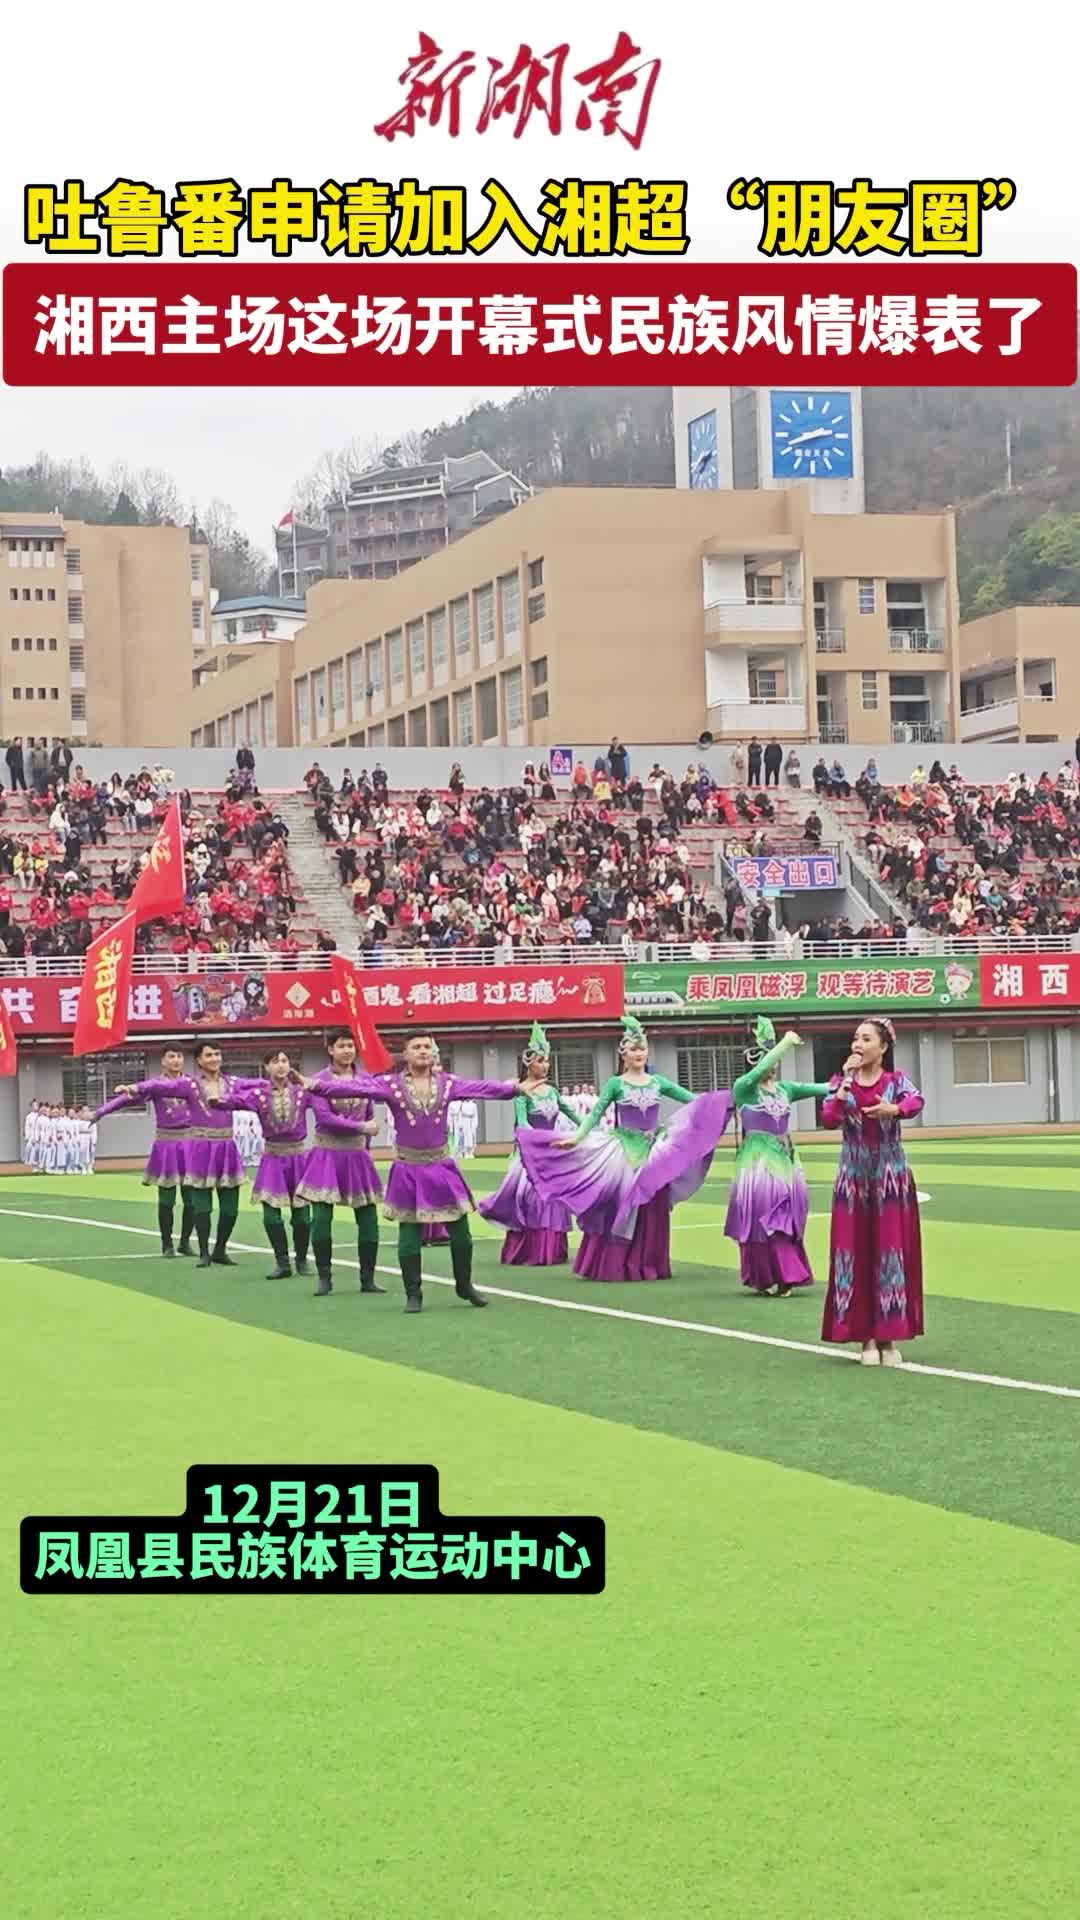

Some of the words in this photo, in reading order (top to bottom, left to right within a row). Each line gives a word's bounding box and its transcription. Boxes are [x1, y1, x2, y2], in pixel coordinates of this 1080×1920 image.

[736, 860, 834, 888] 安全出口
[406, 981, 478, 1004] 看湘超
[686, 972, 808, 1001] 乘凤凰磁浮
[816, 968, 936, 998] 观等待演艺
[992, 963, 1070, 996] 湘西
